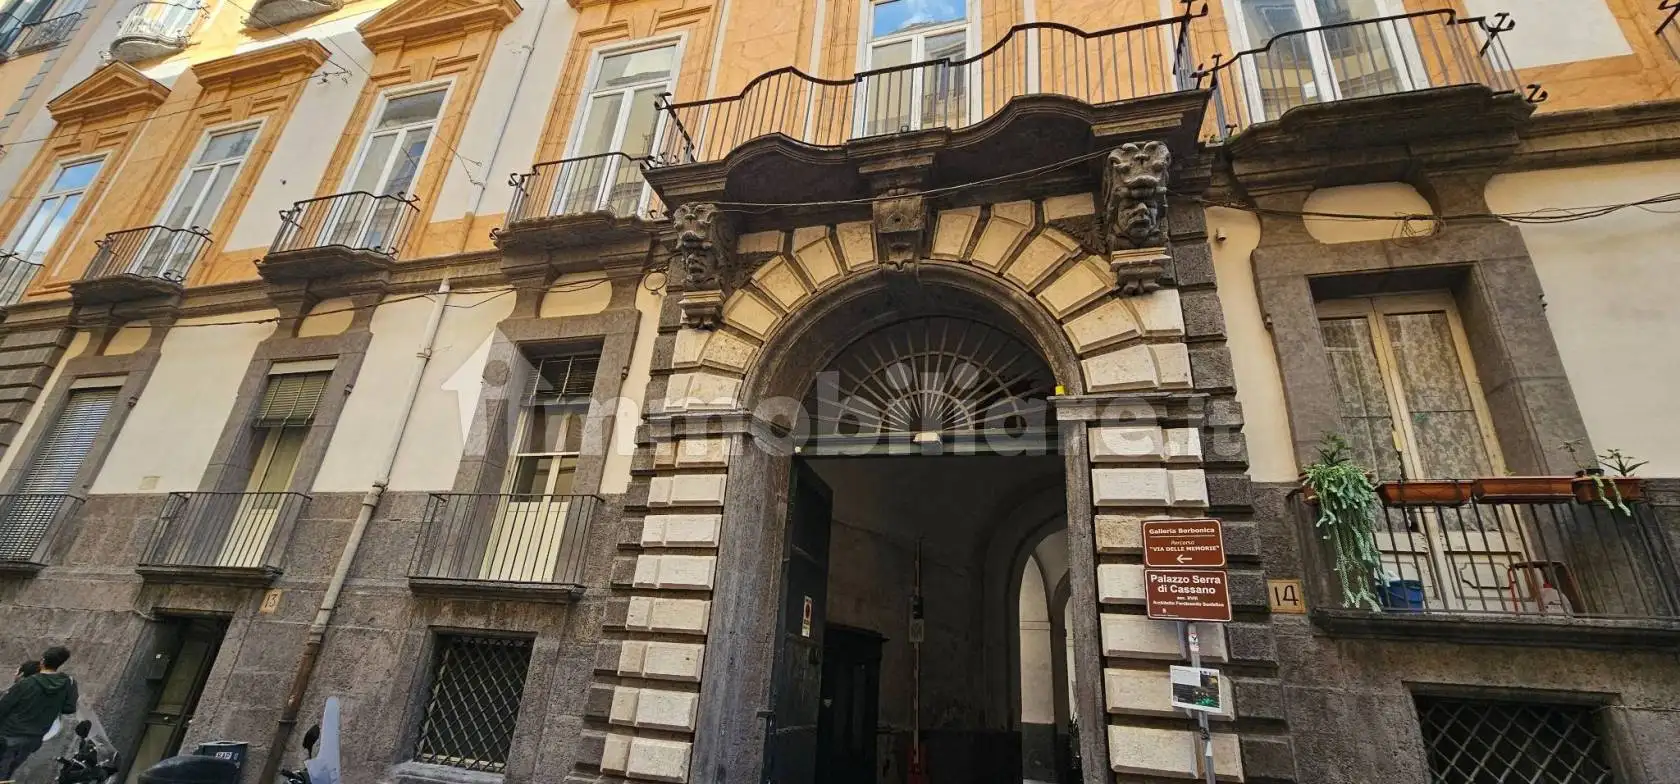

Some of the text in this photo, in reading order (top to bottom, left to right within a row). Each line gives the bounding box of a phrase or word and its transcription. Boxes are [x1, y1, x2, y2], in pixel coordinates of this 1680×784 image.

[1151, 574, 1221, 584] Palazzo Serra
[1158, 584, 1216, 594] di Cassano
[264, 593, 278, 608] 13
[1274, 585, 1299, 606] 14
